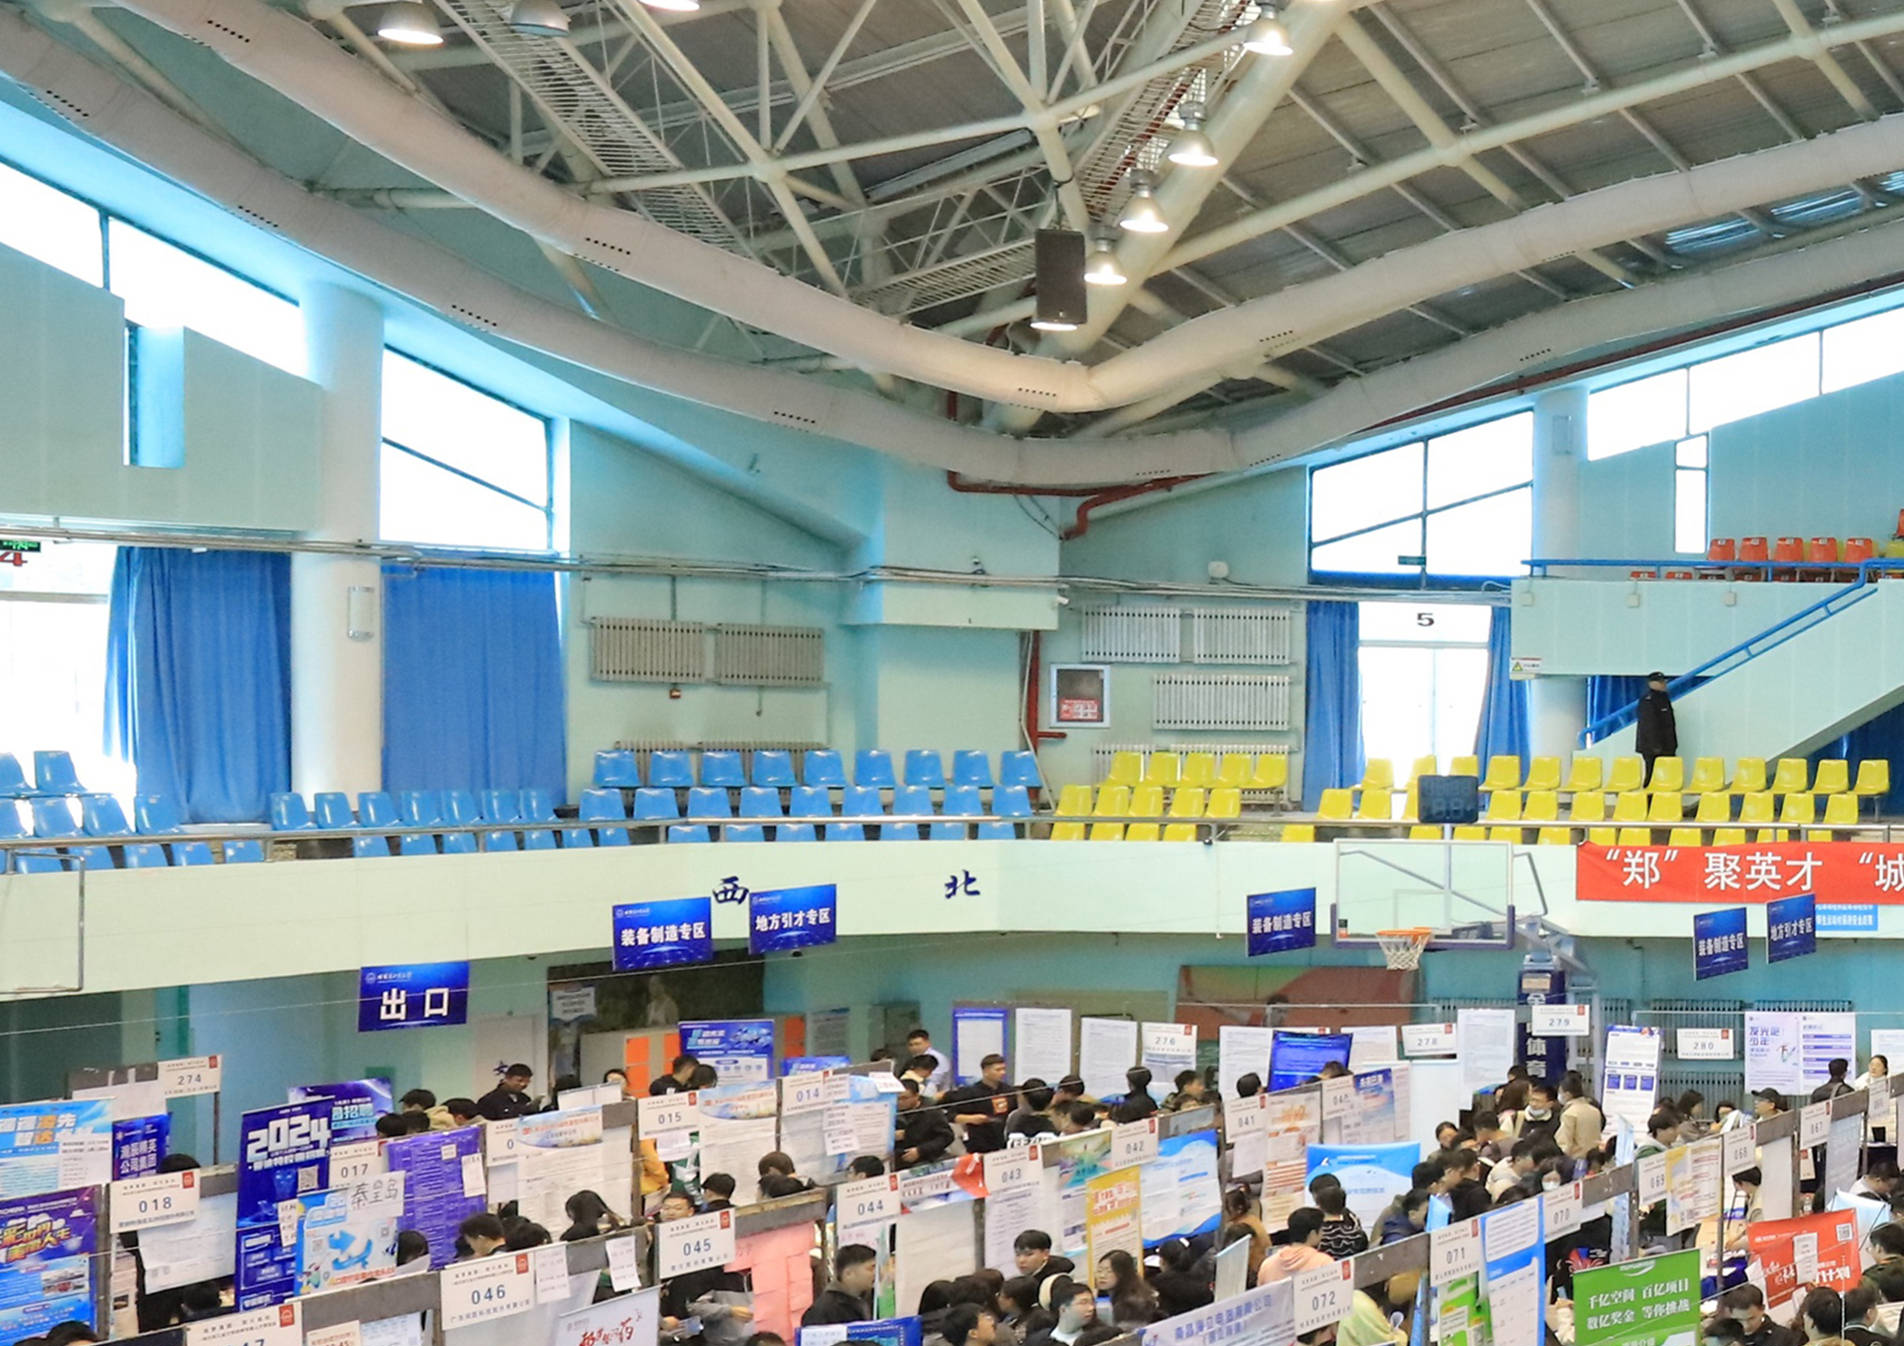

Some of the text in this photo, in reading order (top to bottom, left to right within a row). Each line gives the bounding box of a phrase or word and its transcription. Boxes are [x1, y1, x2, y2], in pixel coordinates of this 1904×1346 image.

[1417, 612, 1434, 627] 5
[1704, 852, 1823, 892] 聚英才
[712, 874, 749, 906] 西
[944, 870, 981, 898] 北
[755, 907, 831, 933] 地方引才专区
[1770, 916, 1813, 943] 地方引才专区
[621, 922, 707, 947] 装备制造专区
[1698, 930, 1745, 958] 装备制造专区
[379, 985, 451, 1021] 出口
[1548, 1018, 1570, 1027] 279
[1693, 1041, 1714, 1051] 280
[177, 1073, 202, 1086] 274
[796, 1087, 820, 1101] 014
[659, 1112, 682, 1124] 015
[247, 1113, 332, 1163] 2024
[340, 1163, 369, 1179] 017
[138, 1196, 172, 1214] 018
[857, 1199, 884, 1216] 044
[683, 1238, 712, 1257] 045
[1446, 1246, 1465, 1265] 071
[471, 1284, 506, 1305] 046
[1311, 1290, 1336, 1311] 072
[1587, 1277, 1690, 1310] 千亿空间 百亿项目
